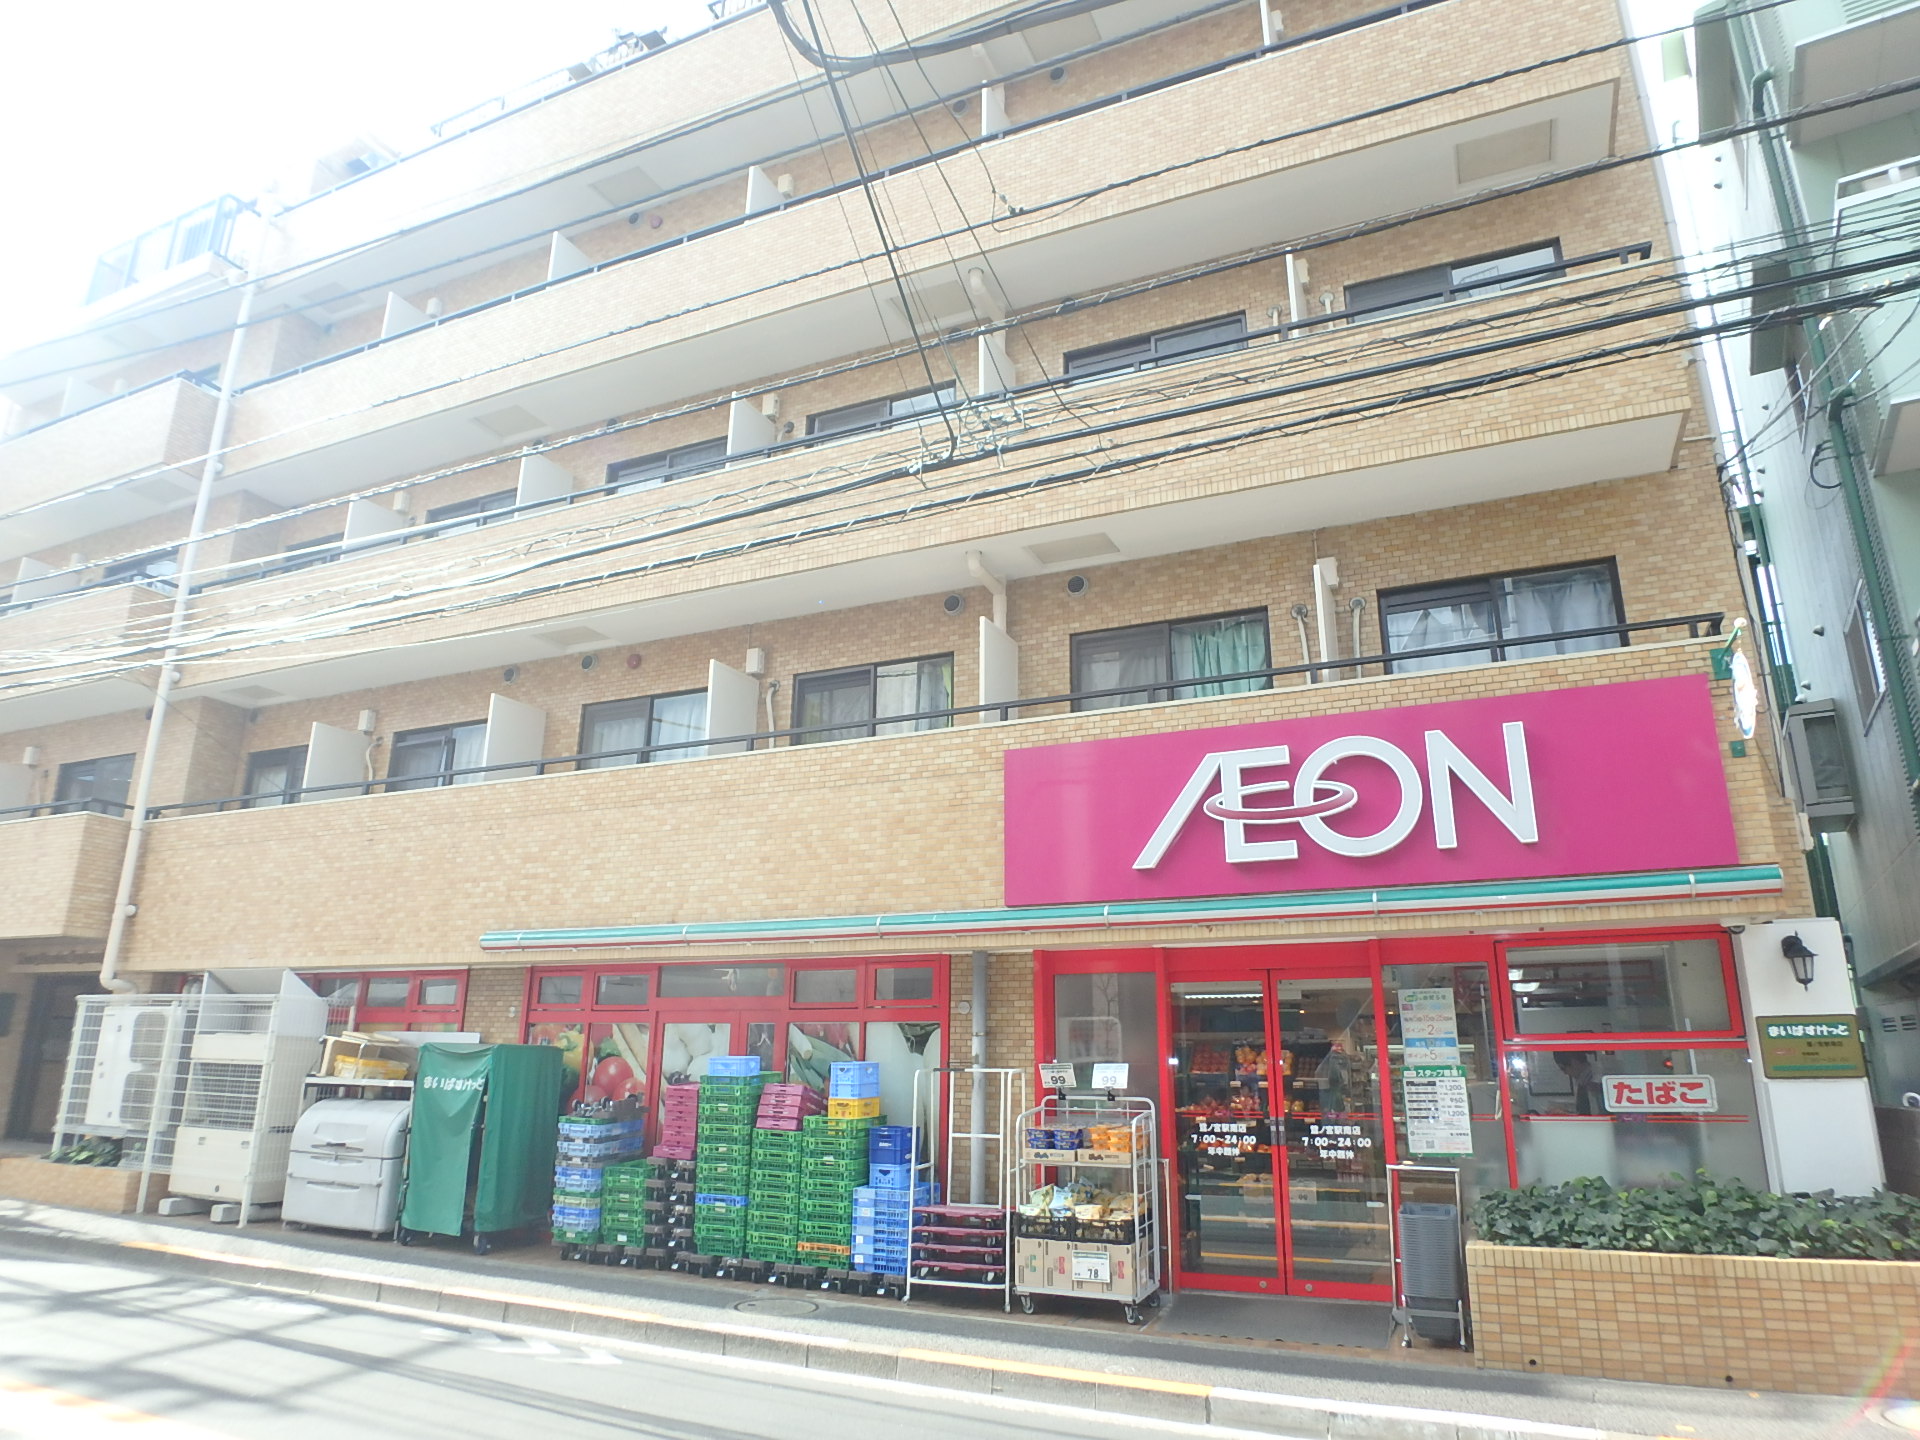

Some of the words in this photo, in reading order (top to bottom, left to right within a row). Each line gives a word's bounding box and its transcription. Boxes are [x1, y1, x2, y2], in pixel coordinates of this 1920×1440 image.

[1768, 1024, 1850, 1037] まいばすけっと
[423, 1075, 486, 1091] まいばすけっと
[1050, 1075, 1066, 1085] 99
[1101, 1075, 1117, 1085] 99
[1612, 1080, 1709, 1105] たばこ
[1087, 1268, 1099, 1279] 78
